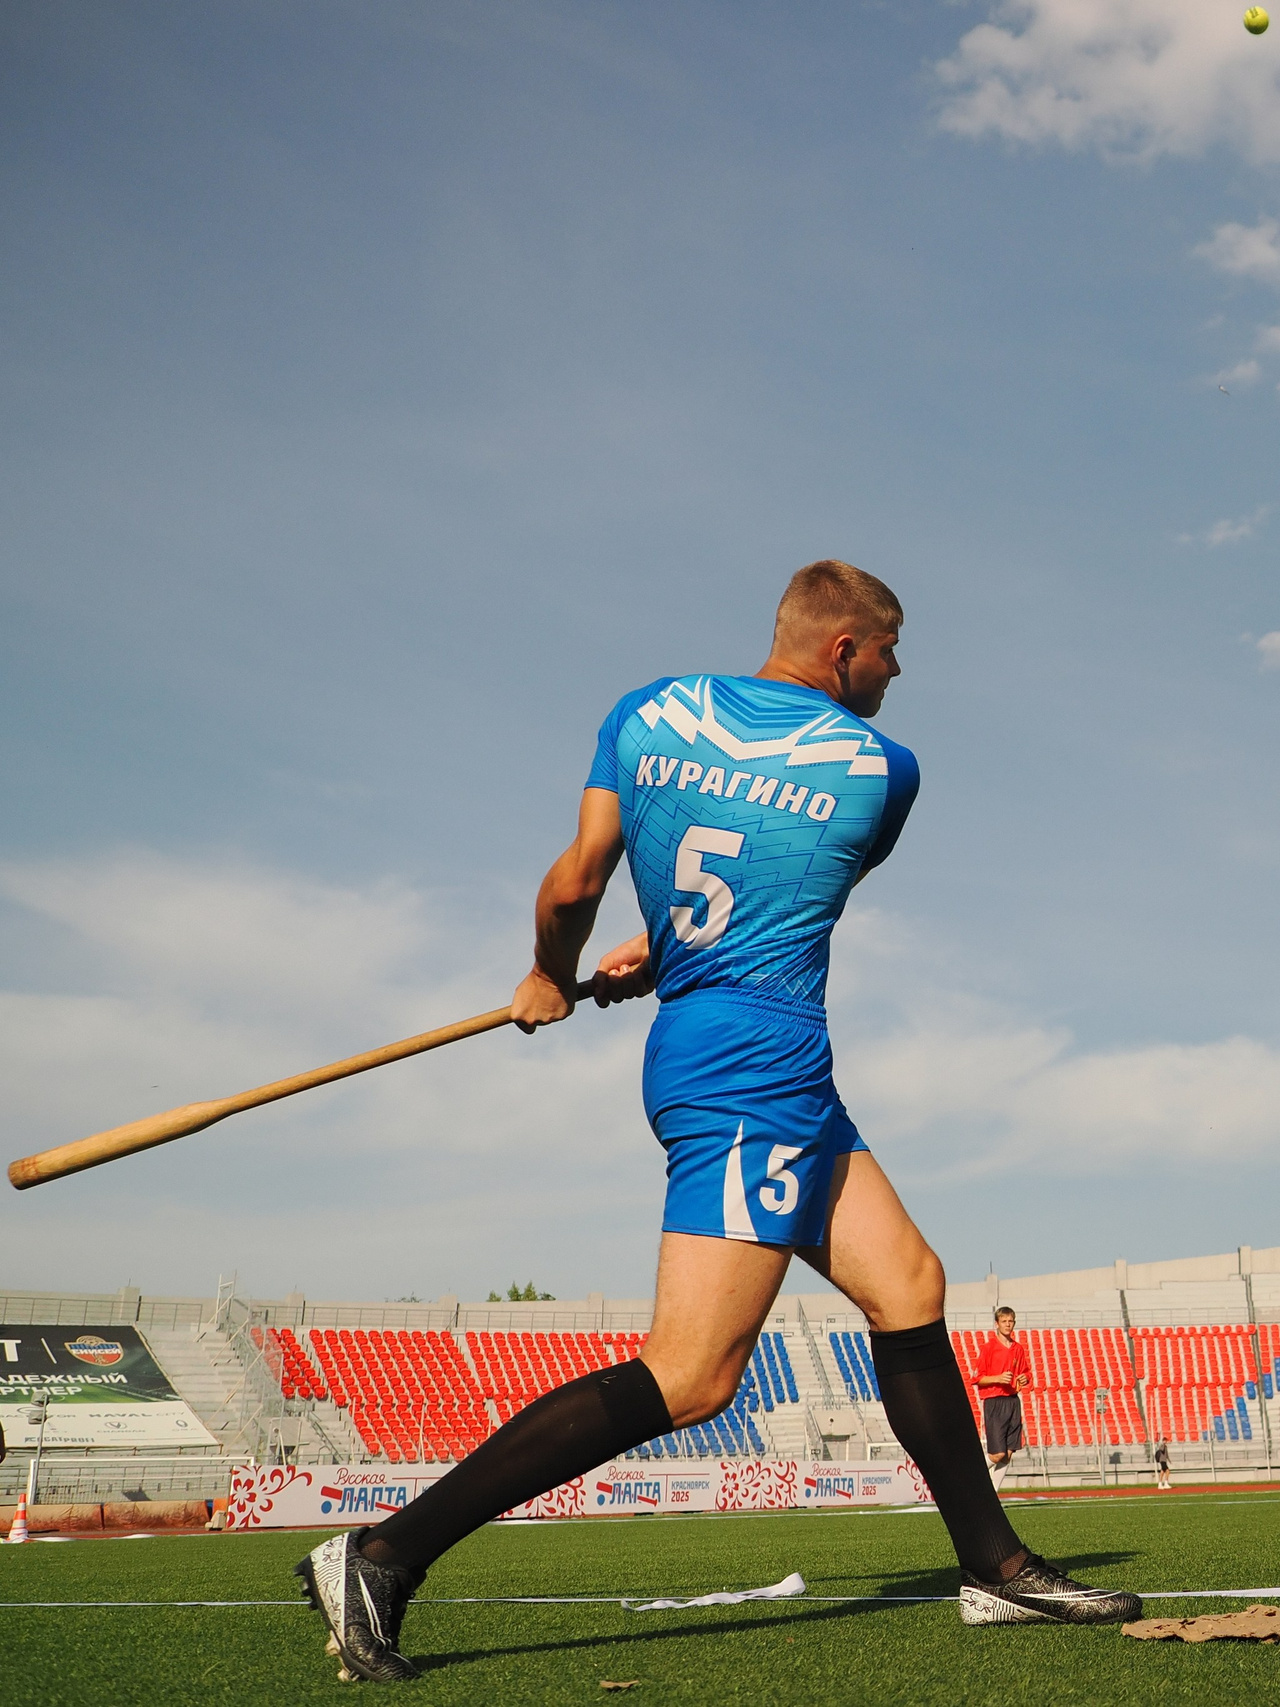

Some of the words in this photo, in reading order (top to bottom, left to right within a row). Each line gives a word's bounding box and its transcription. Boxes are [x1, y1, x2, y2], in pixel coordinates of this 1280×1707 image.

[635, 754, 838, 822] КУРАГИНО
[669, 825, 745, 950] 5
[759, 1143, 803, 1215] 5
[0, 1386, 82, 1396] РТНЕР
[333, 1467, 387, 1485] Русская
[671, 1481, 710, 1490] КРАСНОЯРСК
[862, 1476, 892, 1485] КРАСНОЯРСК
[609, 1481, 661, 1505] ЛАПТА
[671, 1491, 690, 1502] 2025
[814, 1477, 854, 1498] ЛАПТА
[862, 1486, 877, 1496] 2025
[338, 1486, 407, 1513] ЛАПТА
